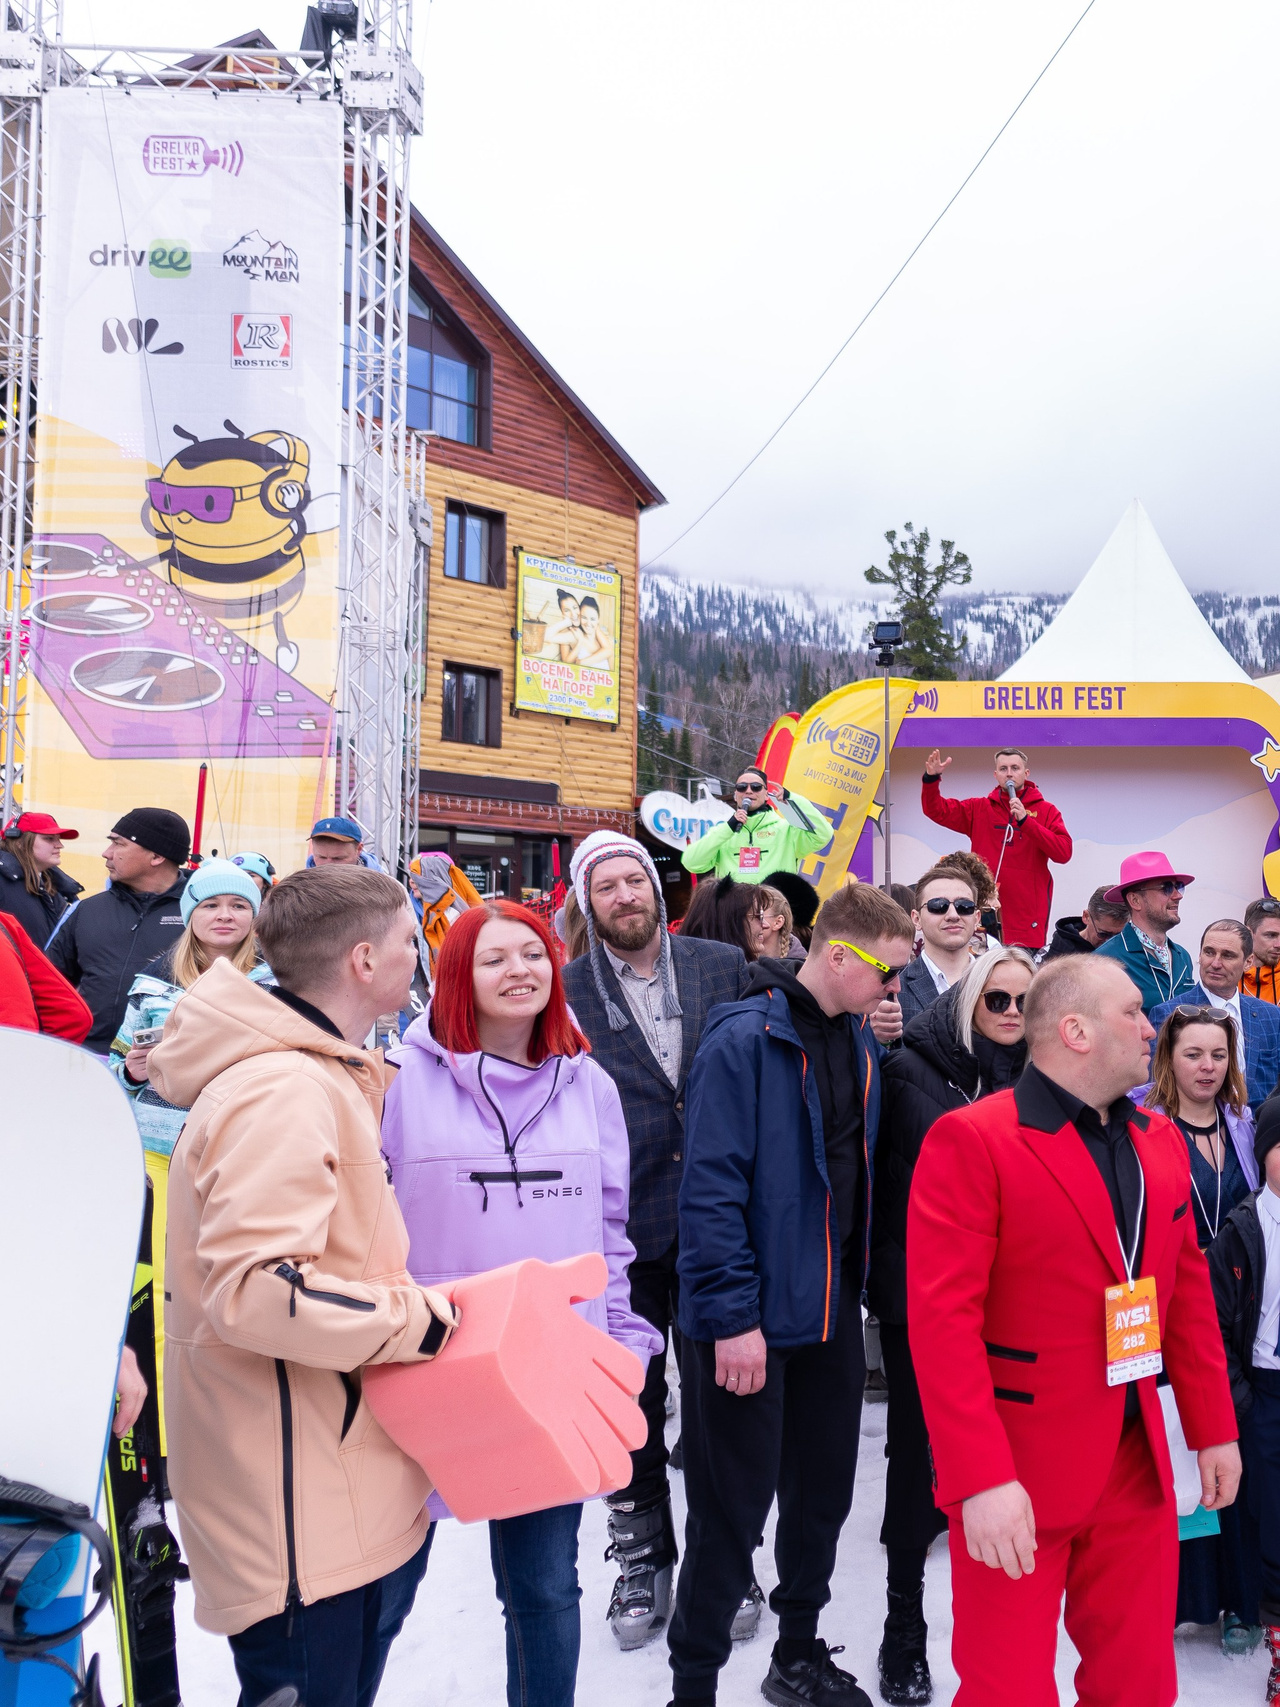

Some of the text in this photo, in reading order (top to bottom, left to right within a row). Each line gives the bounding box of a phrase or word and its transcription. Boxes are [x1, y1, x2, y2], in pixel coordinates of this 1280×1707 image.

[153, 141, 200, 156] GRELKA
[153, 157, 185, 170] FEST
[89, 243, 191, 271] drivee
[223, 255, 298, 270] MOUNTAIN
[265, 269, 300, 283] MAN
[234, 359, 289, 367] ROSTIC'S
[525, 556, 613, 584] КРУГЛОСУТОЧНО
[523, 659, 613, 686] ВОСЕМЬ БАНЬ
[543, 678, 594, 696] НА ГОРЕ
[984, 686, 1126, 710] GRELKA FEST
[532, 1187, 582, 1199] SNEG
[1115, 1305, 1150, 1331] AYS!
[1123, 1333, 1146, 1350] 282
